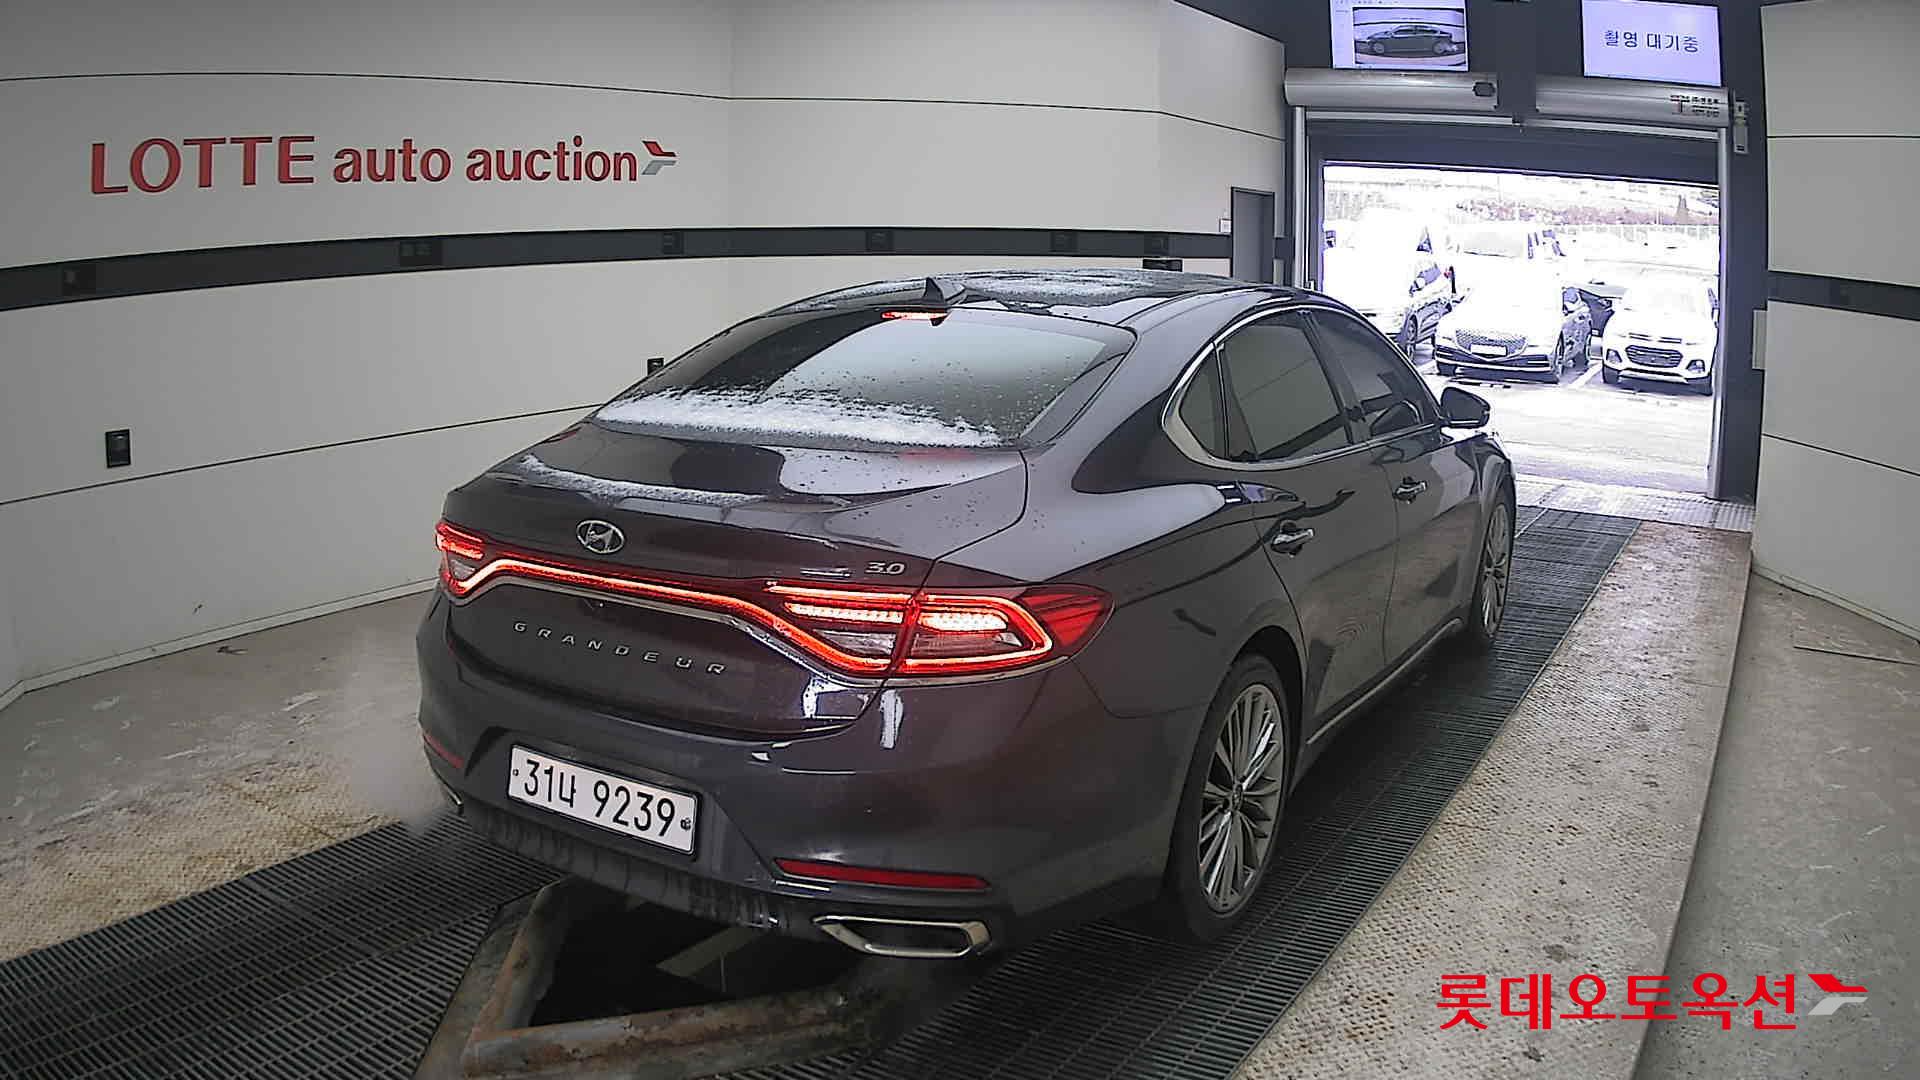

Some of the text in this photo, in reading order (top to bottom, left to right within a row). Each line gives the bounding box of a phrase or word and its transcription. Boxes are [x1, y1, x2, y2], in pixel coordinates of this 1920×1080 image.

[1646, 33, 1699, 53] 대기중
[91, 135, 638, 194] LOTTE auto auction
[513, 621, 725, 675] GRANDEUR
[593, 780, 676, 837] 9239
